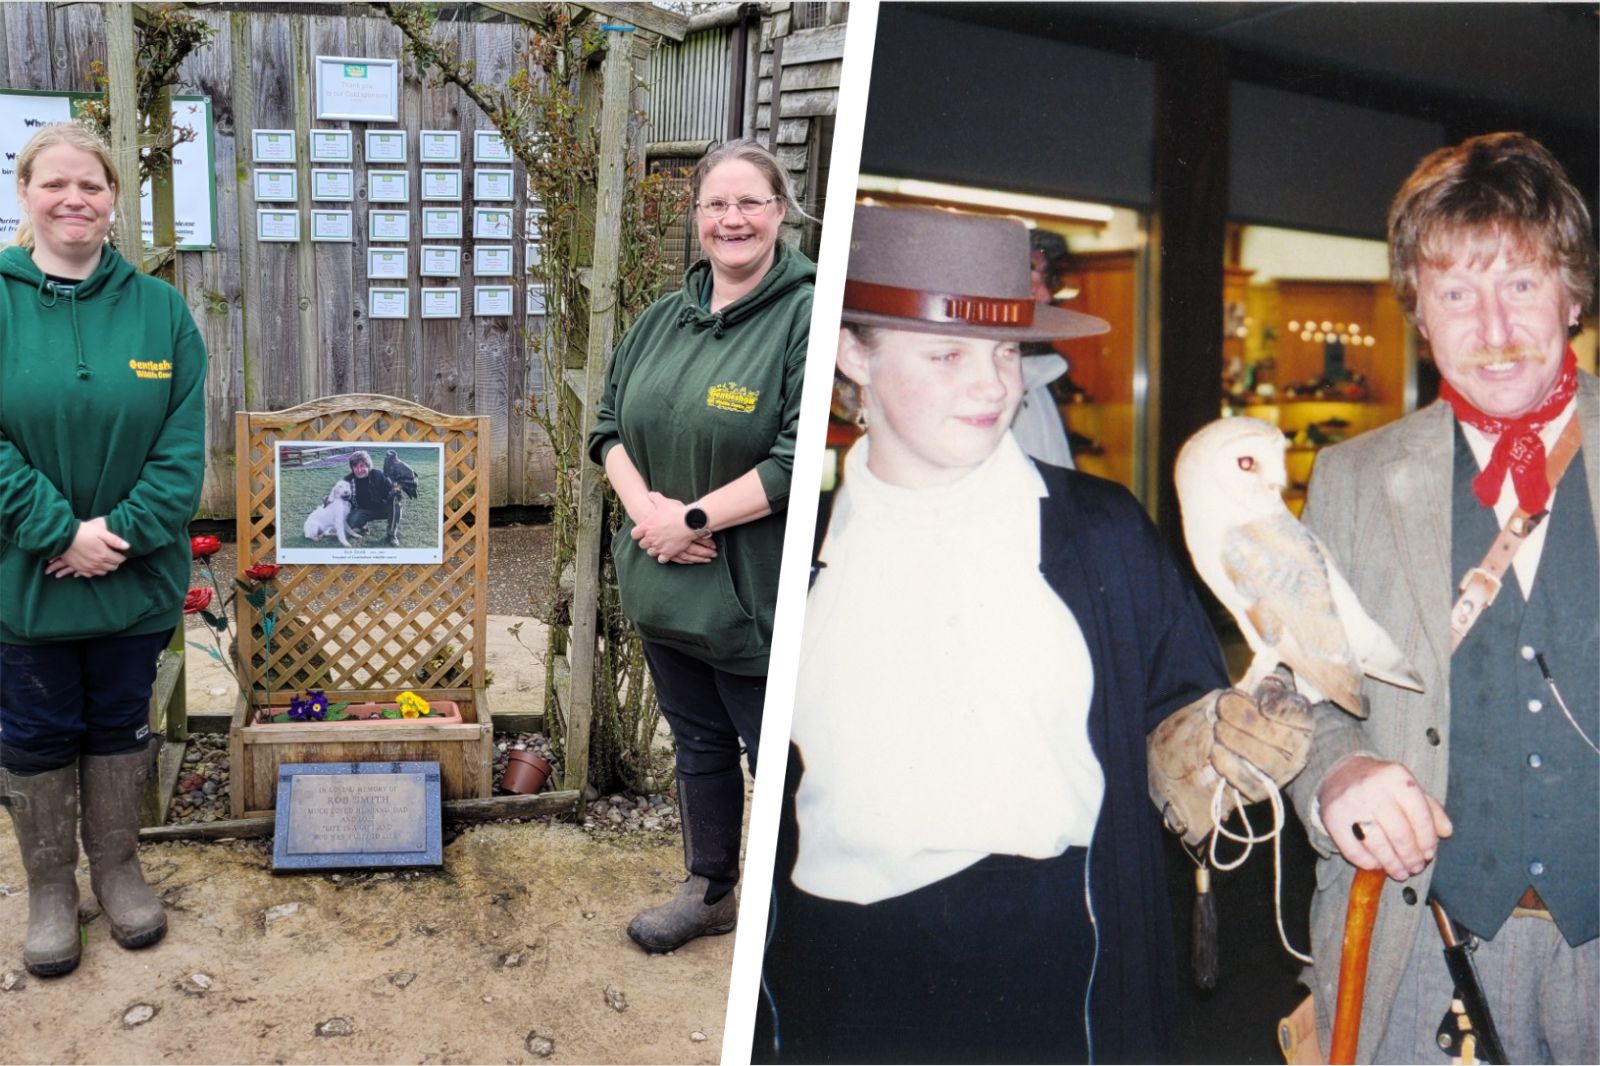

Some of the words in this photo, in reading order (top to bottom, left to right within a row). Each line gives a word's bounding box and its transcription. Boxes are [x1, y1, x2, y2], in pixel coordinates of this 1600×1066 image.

[357, 785, 387, 793] MEMORY
[327, 796, 349, 805] ROB
[352, 795, 390, 804] SMITH
